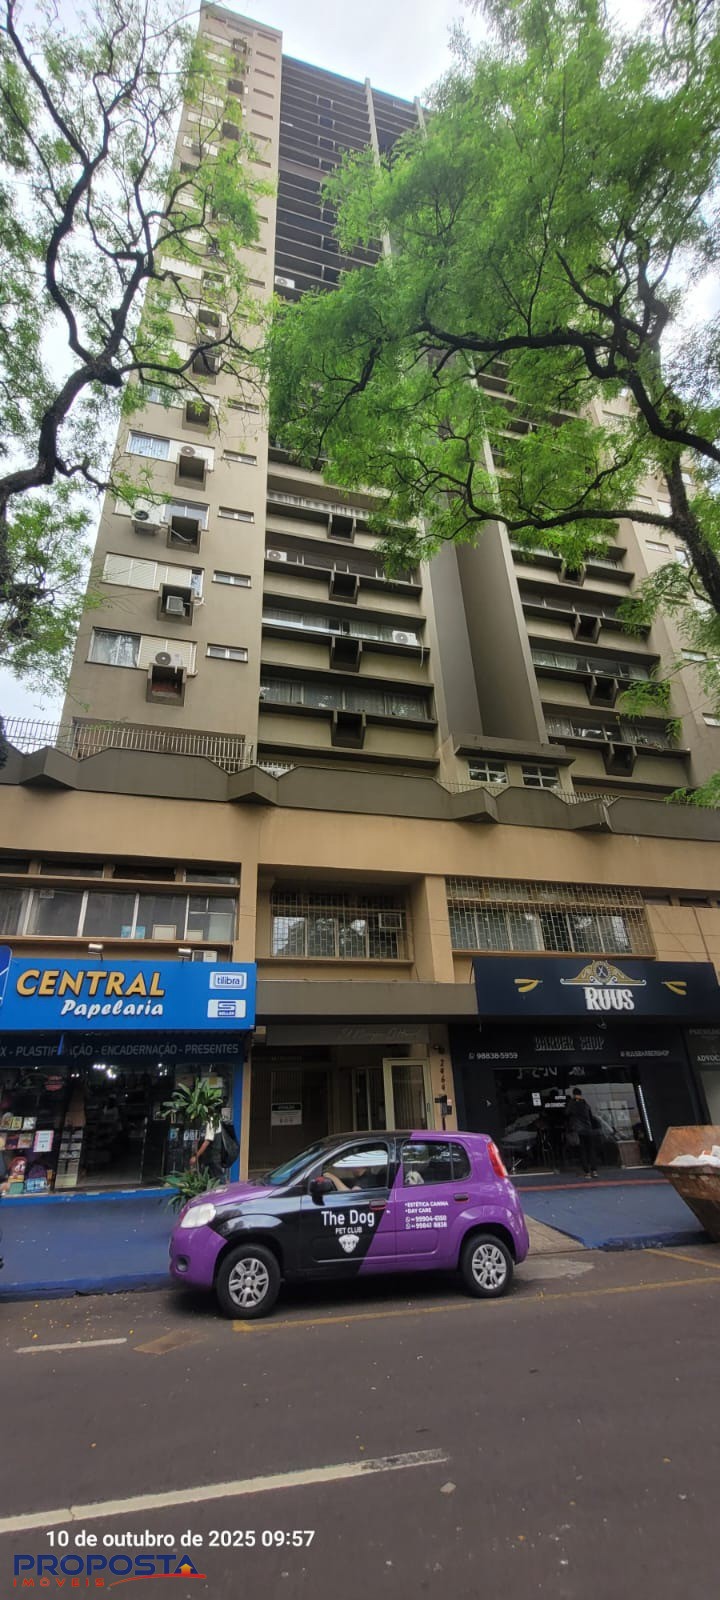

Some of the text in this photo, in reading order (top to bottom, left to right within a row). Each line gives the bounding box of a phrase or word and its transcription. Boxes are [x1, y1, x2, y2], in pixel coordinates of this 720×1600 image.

[16, 969, 165, 998] CENTRAL
[217, 976, 240, 985] tilibra
[583, 986, 635, 1011] RUUS
[60, 999, 164, 1019] Papelaria
[100, 1042, 177, 1057] ENCADERNAÇÃO
[184, 1043, 239, 1055] PRESENTES
[320, 1209, 375, 1227] The Dog
[347, 1226, 363, 1234] CLUB
